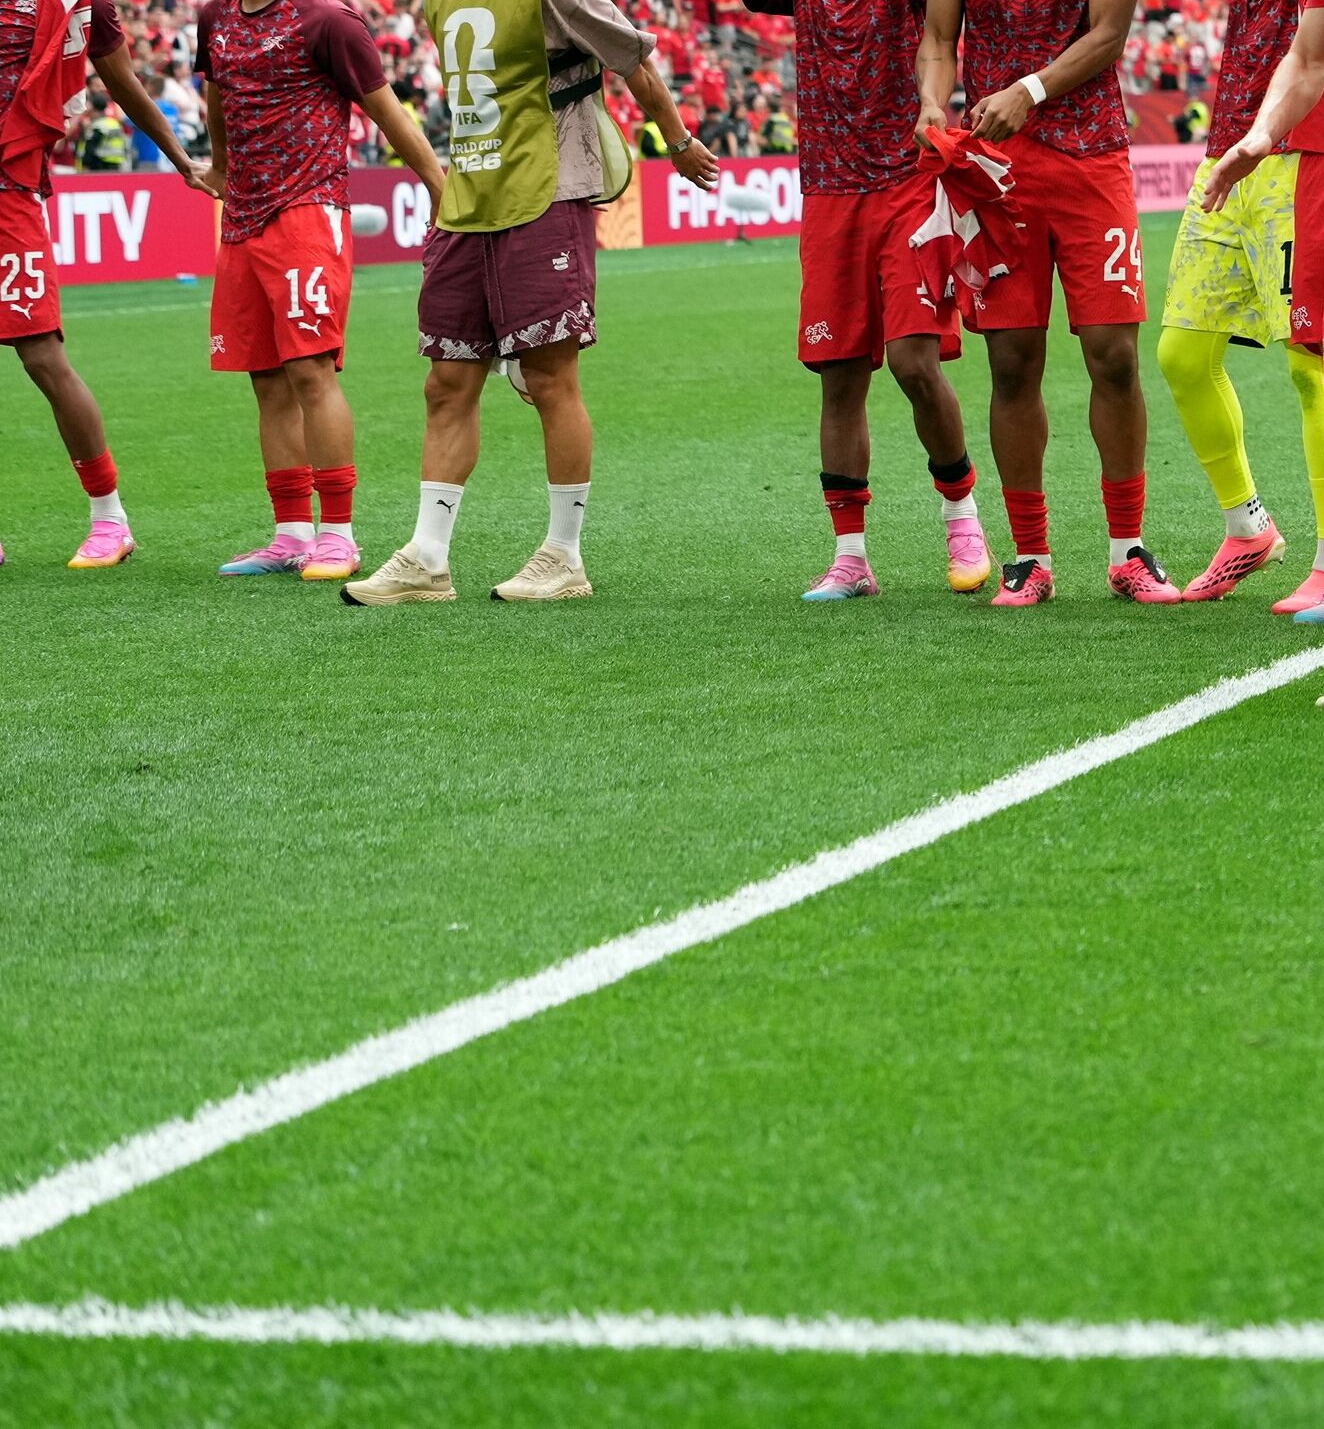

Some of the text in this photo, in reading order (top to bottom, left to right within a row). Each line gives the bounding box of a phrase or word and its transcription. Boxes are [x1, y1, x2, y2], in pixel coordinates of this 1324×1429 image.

[456, 111, 482, 126] IFA
[451, 139, 502, 154] ORLD CUP
[0, 251, 46, 302] 25
[1103, 227, 1142, 282] 24
[285, 266, 330, 319] 14
